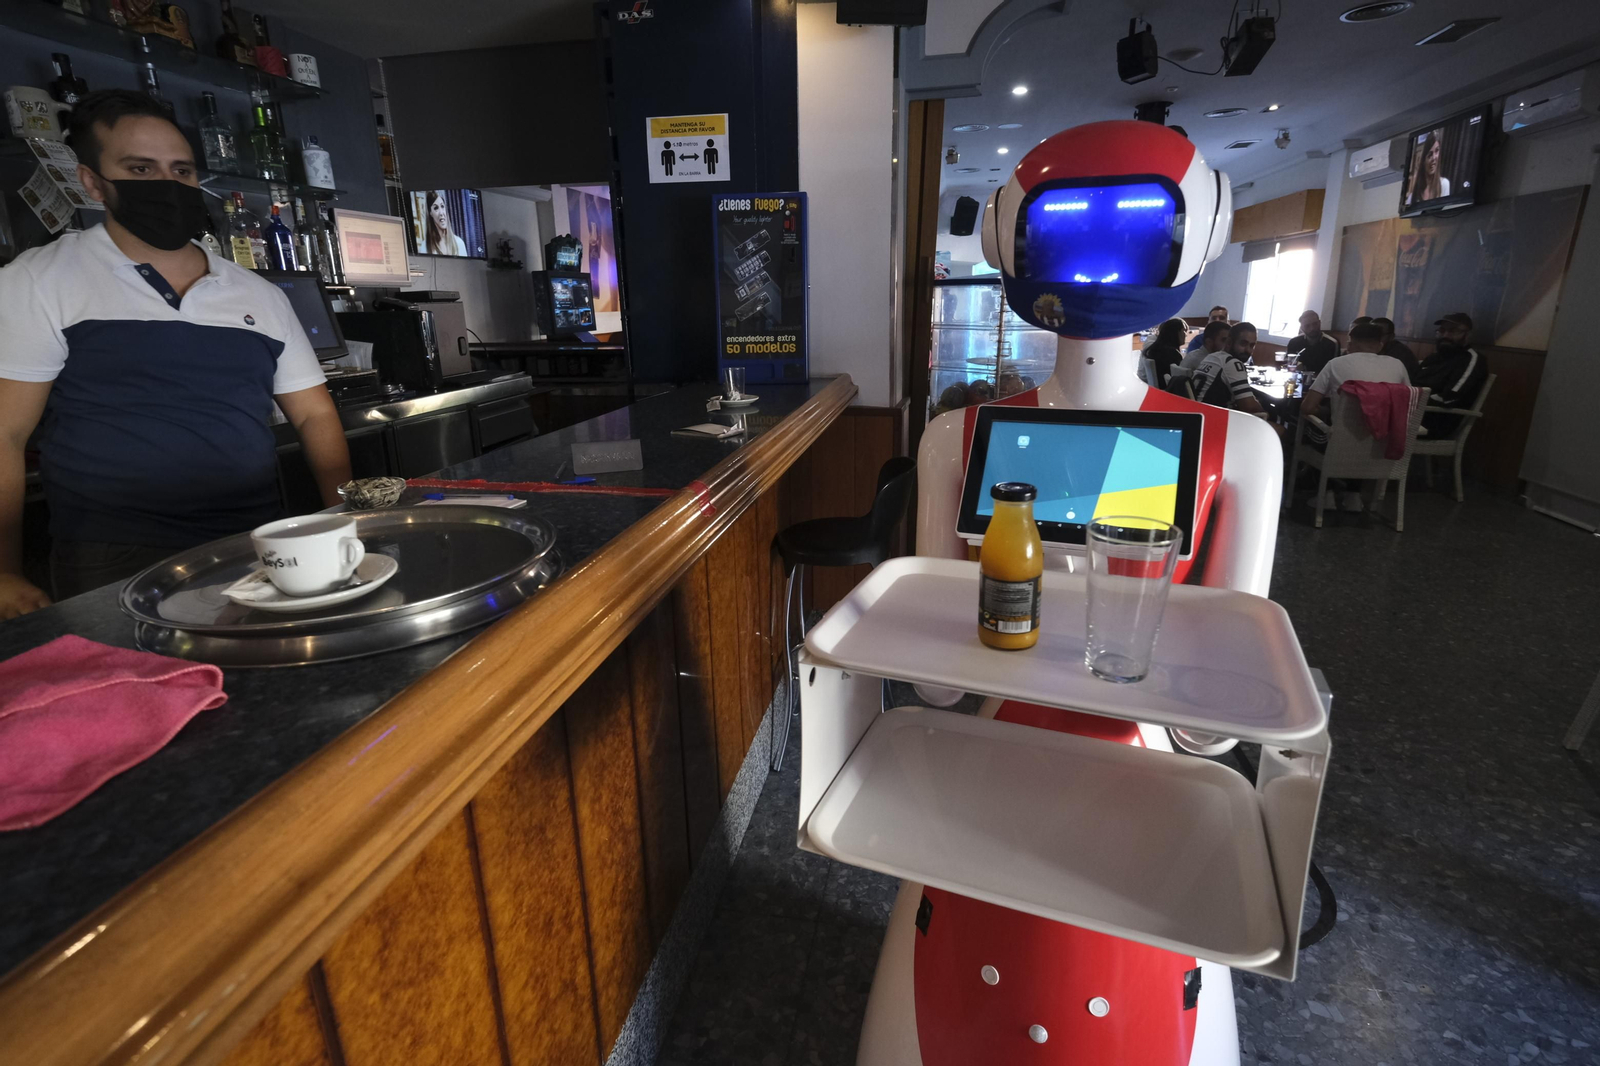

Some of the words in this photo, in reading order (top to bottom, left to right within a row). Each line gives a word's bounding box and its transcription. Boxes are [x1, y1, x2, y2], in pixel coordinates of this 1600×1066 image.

[619, 10, 652, 20] DAS
[754, 197, 785, 213] fuego?
[726, 335, 774, 343] encendedores
[777, 334, 796, 342] extra
[726, 343, 741, 354] 50
[745, 342, 796, 354] modelos
